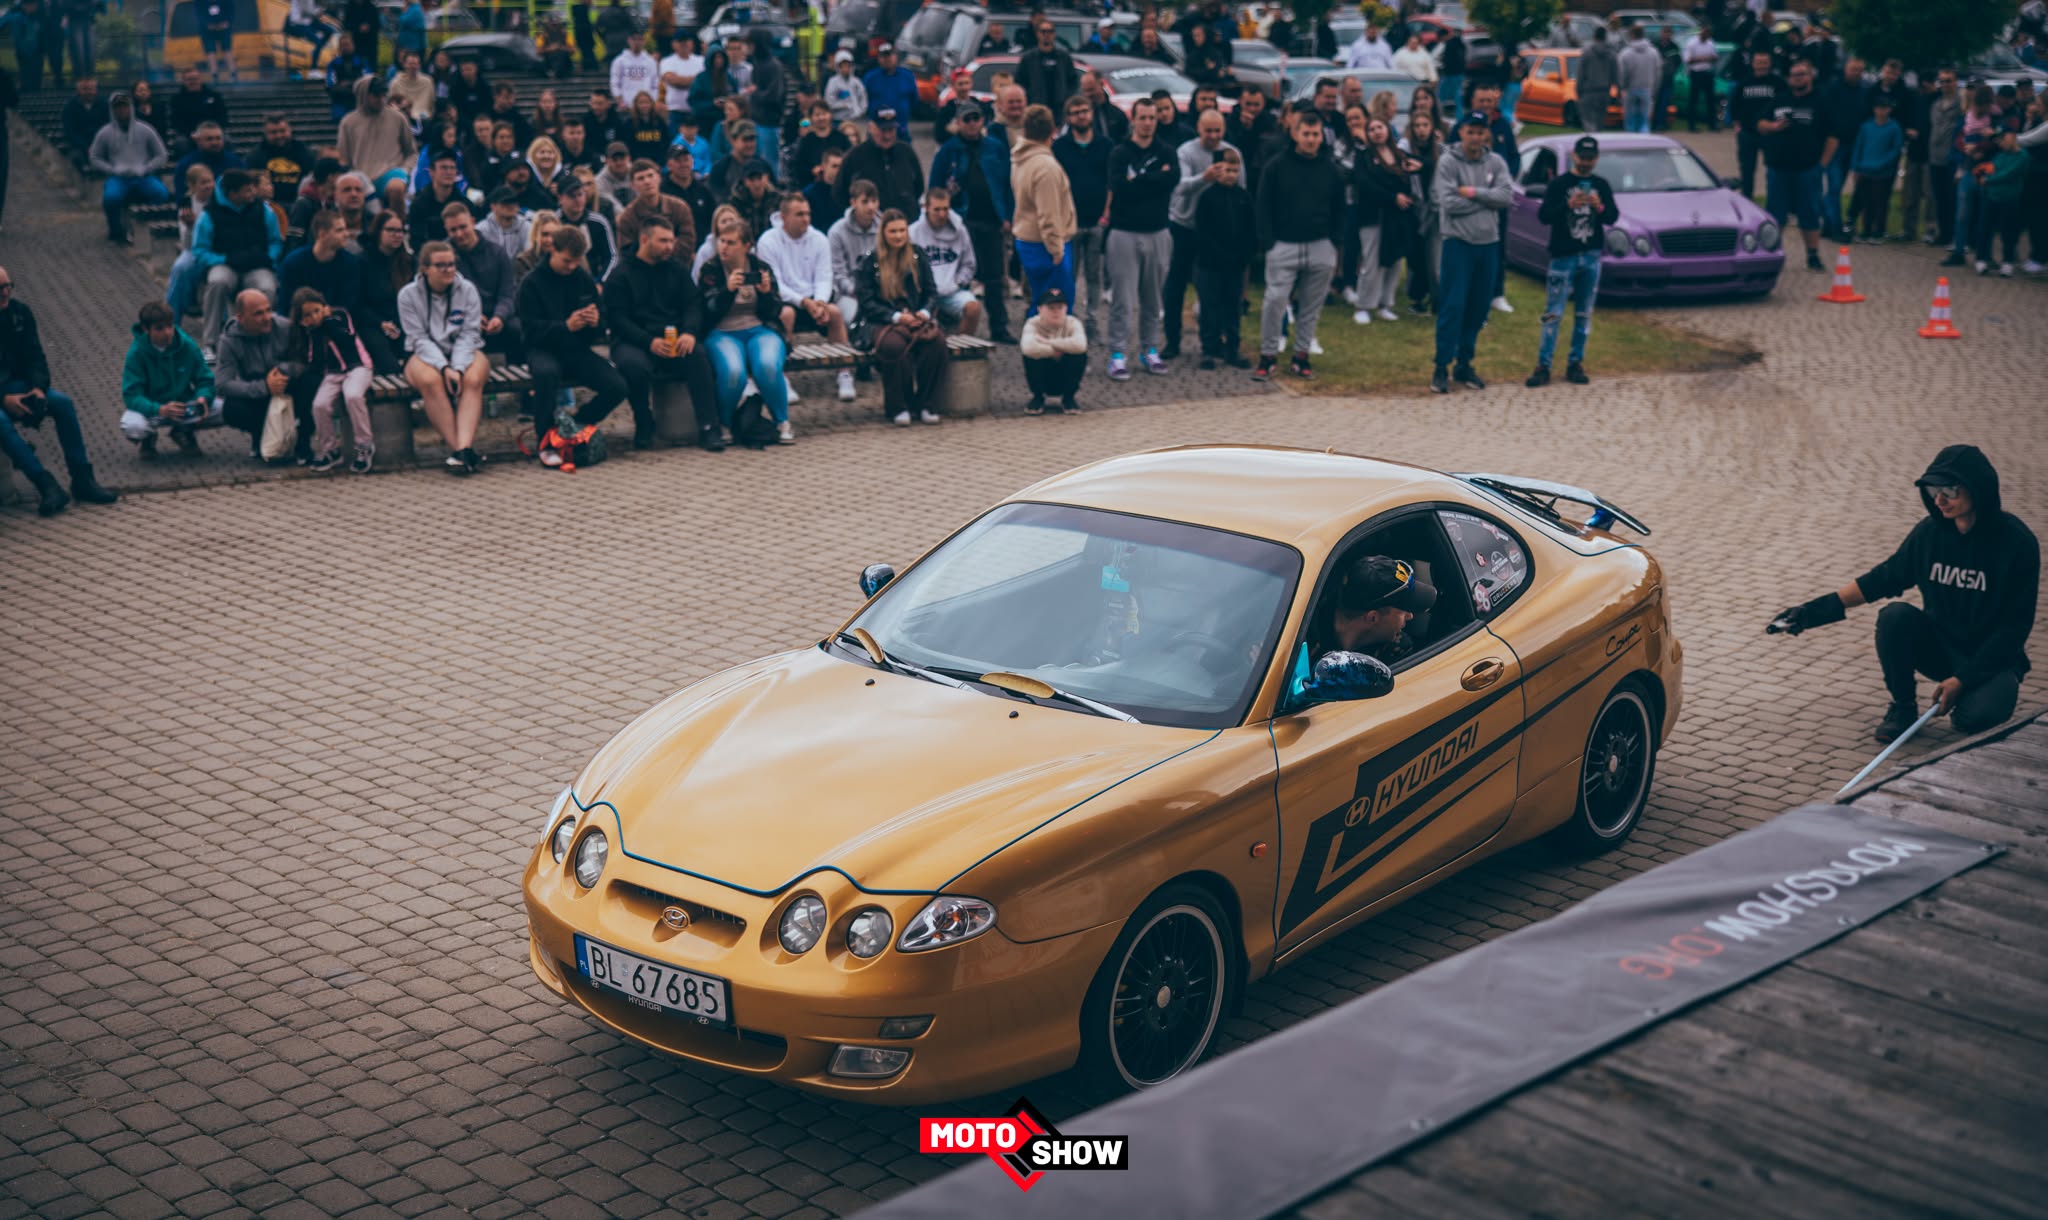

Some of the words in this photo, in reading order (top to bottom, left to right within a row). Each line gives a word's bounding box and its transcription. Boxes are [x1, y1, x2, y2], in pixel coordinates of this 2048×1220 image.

[1929, 562, 1986, 592] NASA
[1375, 720, 1479, 815] HYUNDAI
[580, 959, 588, 971] PL
[592, 946, 622, 987] BL
[632, 963, 718, 1015] 67685
[628, 995, 662, 1013] HYUNDAI
